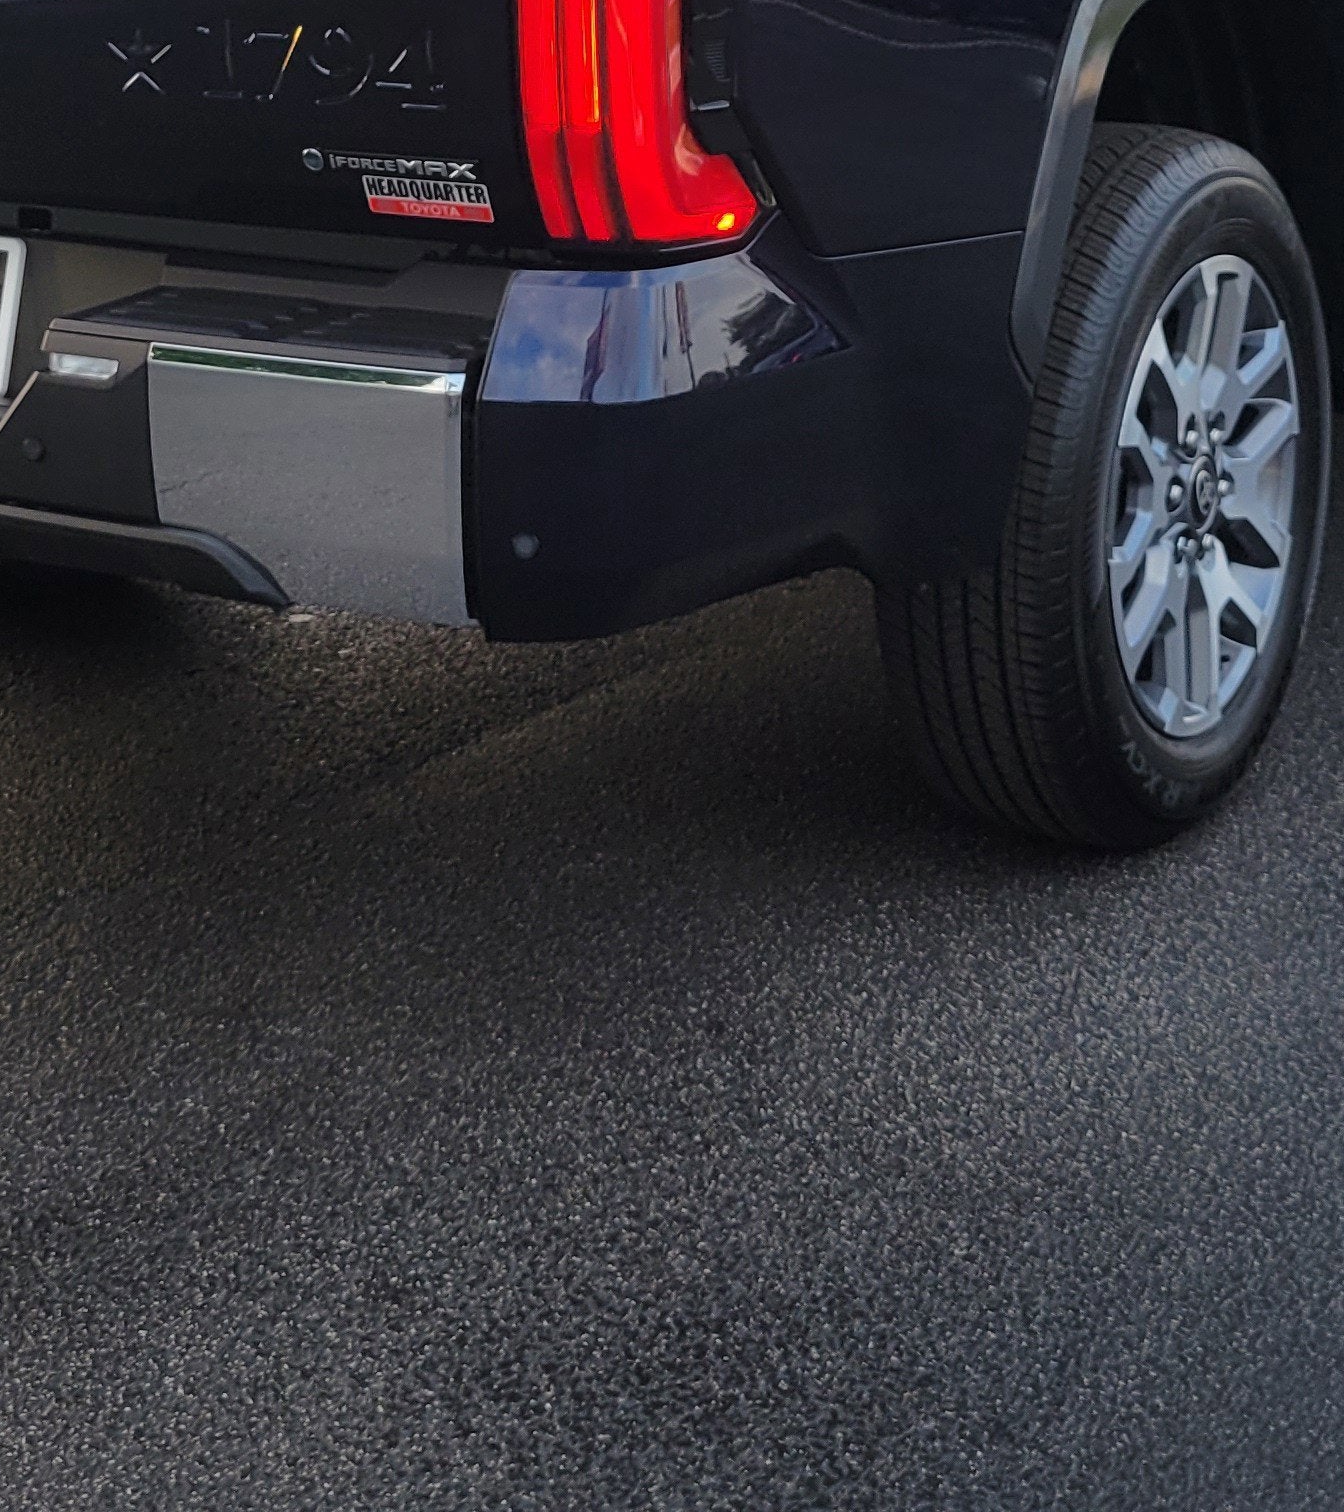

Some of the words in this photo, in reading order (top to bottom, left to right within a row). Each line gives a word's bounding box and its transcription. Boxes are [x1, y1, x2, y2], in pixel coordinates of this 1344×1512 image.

[195, 18, 447, 110] 1794
[365, 177, 487, 205] HEADQUARTER
[400, 202, 460, 217] TOYOTA
